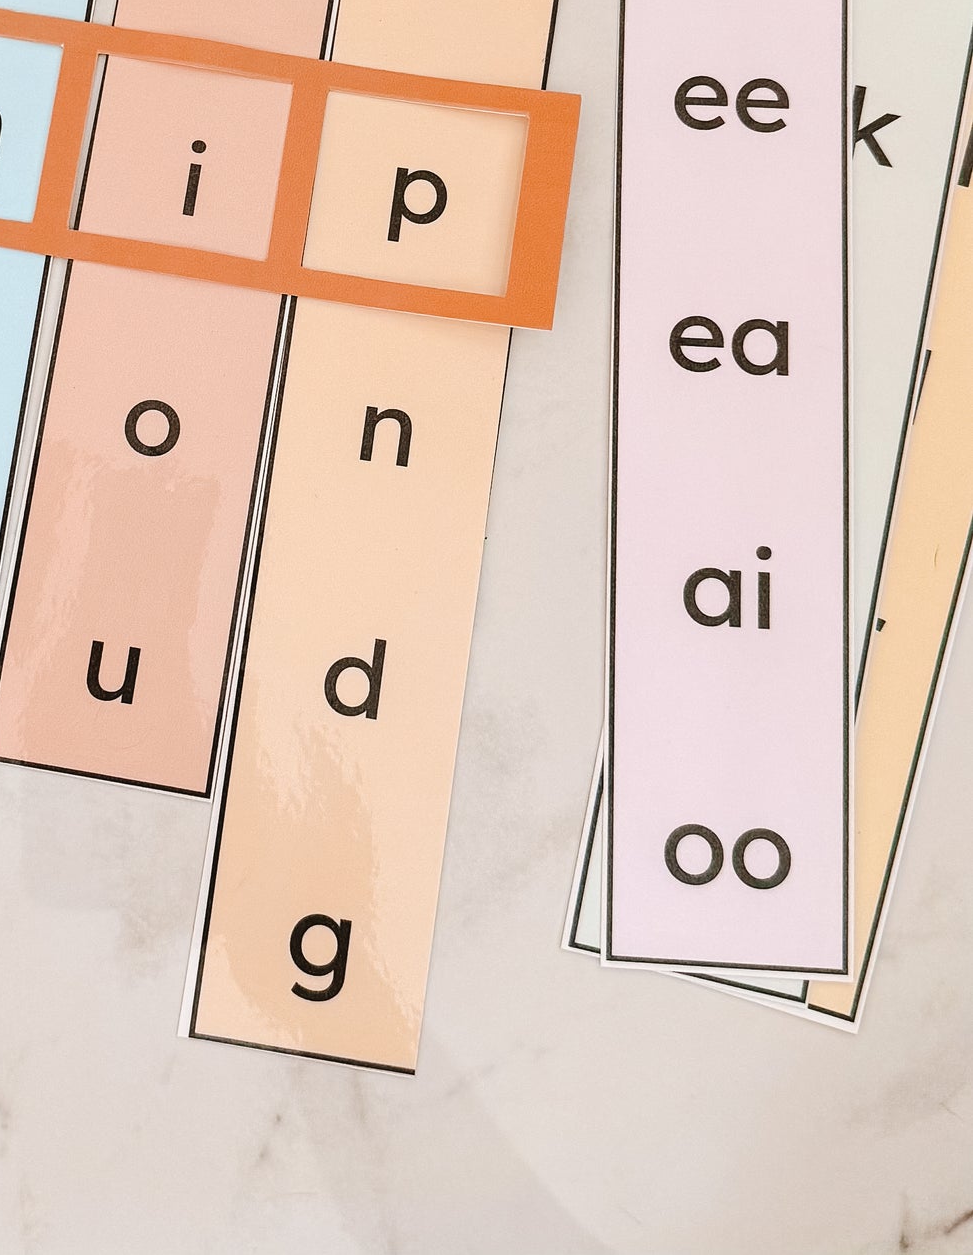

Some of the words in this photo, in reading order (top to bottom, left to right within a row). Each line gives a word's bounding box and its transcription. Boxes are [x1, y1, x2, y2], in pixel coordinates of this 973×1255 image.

[674, 74, 791, 134] ee
[181, 139, 208, 218] i
[386, 166, 449, 244] p
[668, 314, 790, 378] ea
[123, 398, 182, 458] o
[359, 404, 414, 469] n
[682, 545, 773, 630] ai
[85, 639, 143, 706] u
[323, 637, 388, 721] d
[663, 823, 793, 891] oo
[289, 912, 353, 1003] g
